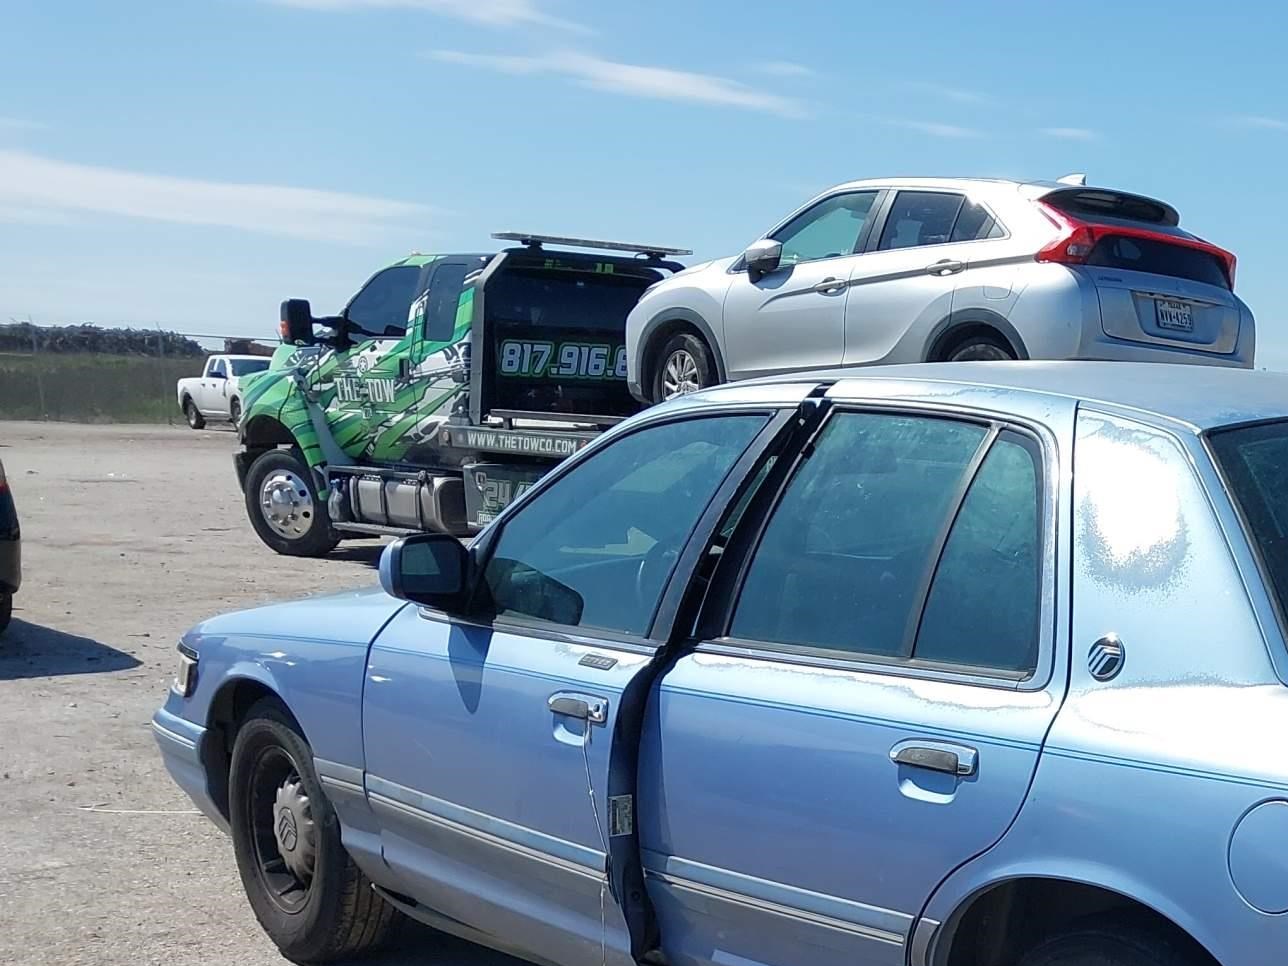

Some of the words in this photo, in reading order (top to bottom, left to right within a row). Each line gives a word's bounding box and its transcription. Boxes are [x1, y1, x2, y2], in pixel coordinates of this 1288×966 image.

[334, 376, 361, 401] THE
[365, 379, 395, 403] TOW
[467, 431, 577, 454] WWW.THETOWCO.COM
